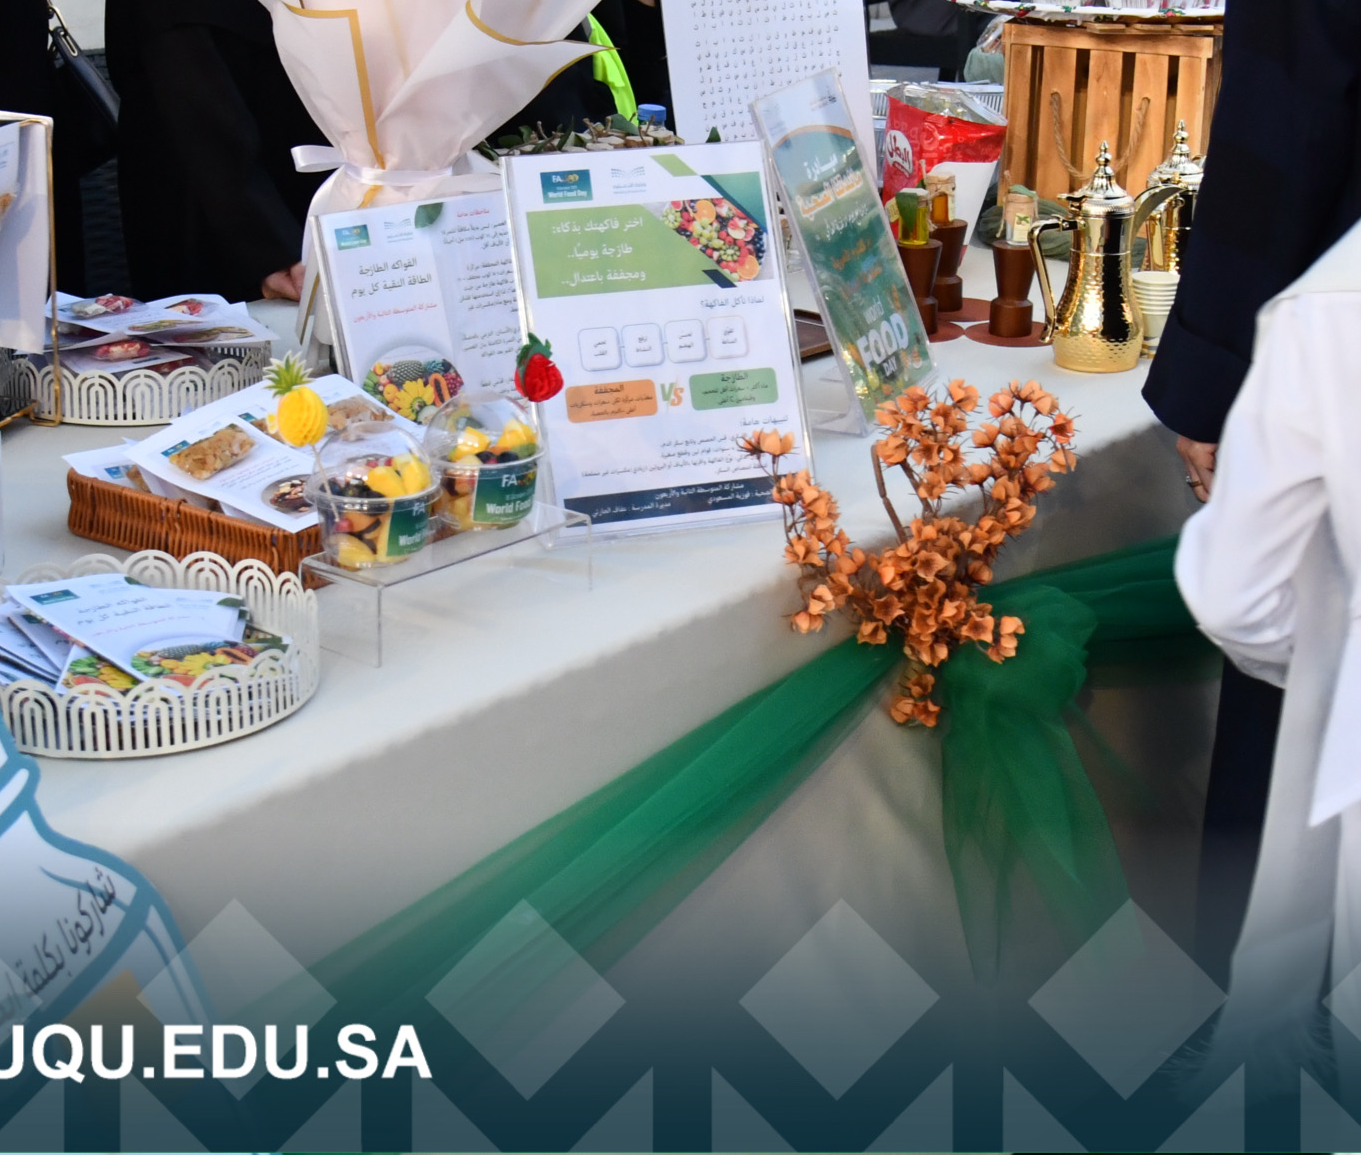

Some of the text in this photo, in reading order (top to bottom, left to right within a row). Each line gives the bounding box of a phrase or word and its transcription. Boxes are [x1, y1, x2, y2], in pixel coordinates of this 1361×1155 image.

[584, 217, 620, 233] فاكهتك
[623, 216, 644, 232] اختر
[601, 243, 633, 258] طازجة
[359, 257, 418, 277] الفواكه الطازجة
[407, 273, 432, 286] الطاقة
[606, 269, 646, 282] ومجففة
[351, 287, 366, 299] يوم
[368, 281, 380, 296] كل
[747, 295, 765, 305] لماذا
[856, 312, 909, 374] FOOD
[882, 356, 898, 377] DAY
[660, 382, 685, 407] VS
[485, 502, 514, 514] World
[56, 865, 118, 957] شاركونا
[15, 932, 73, 996] بكلمة
